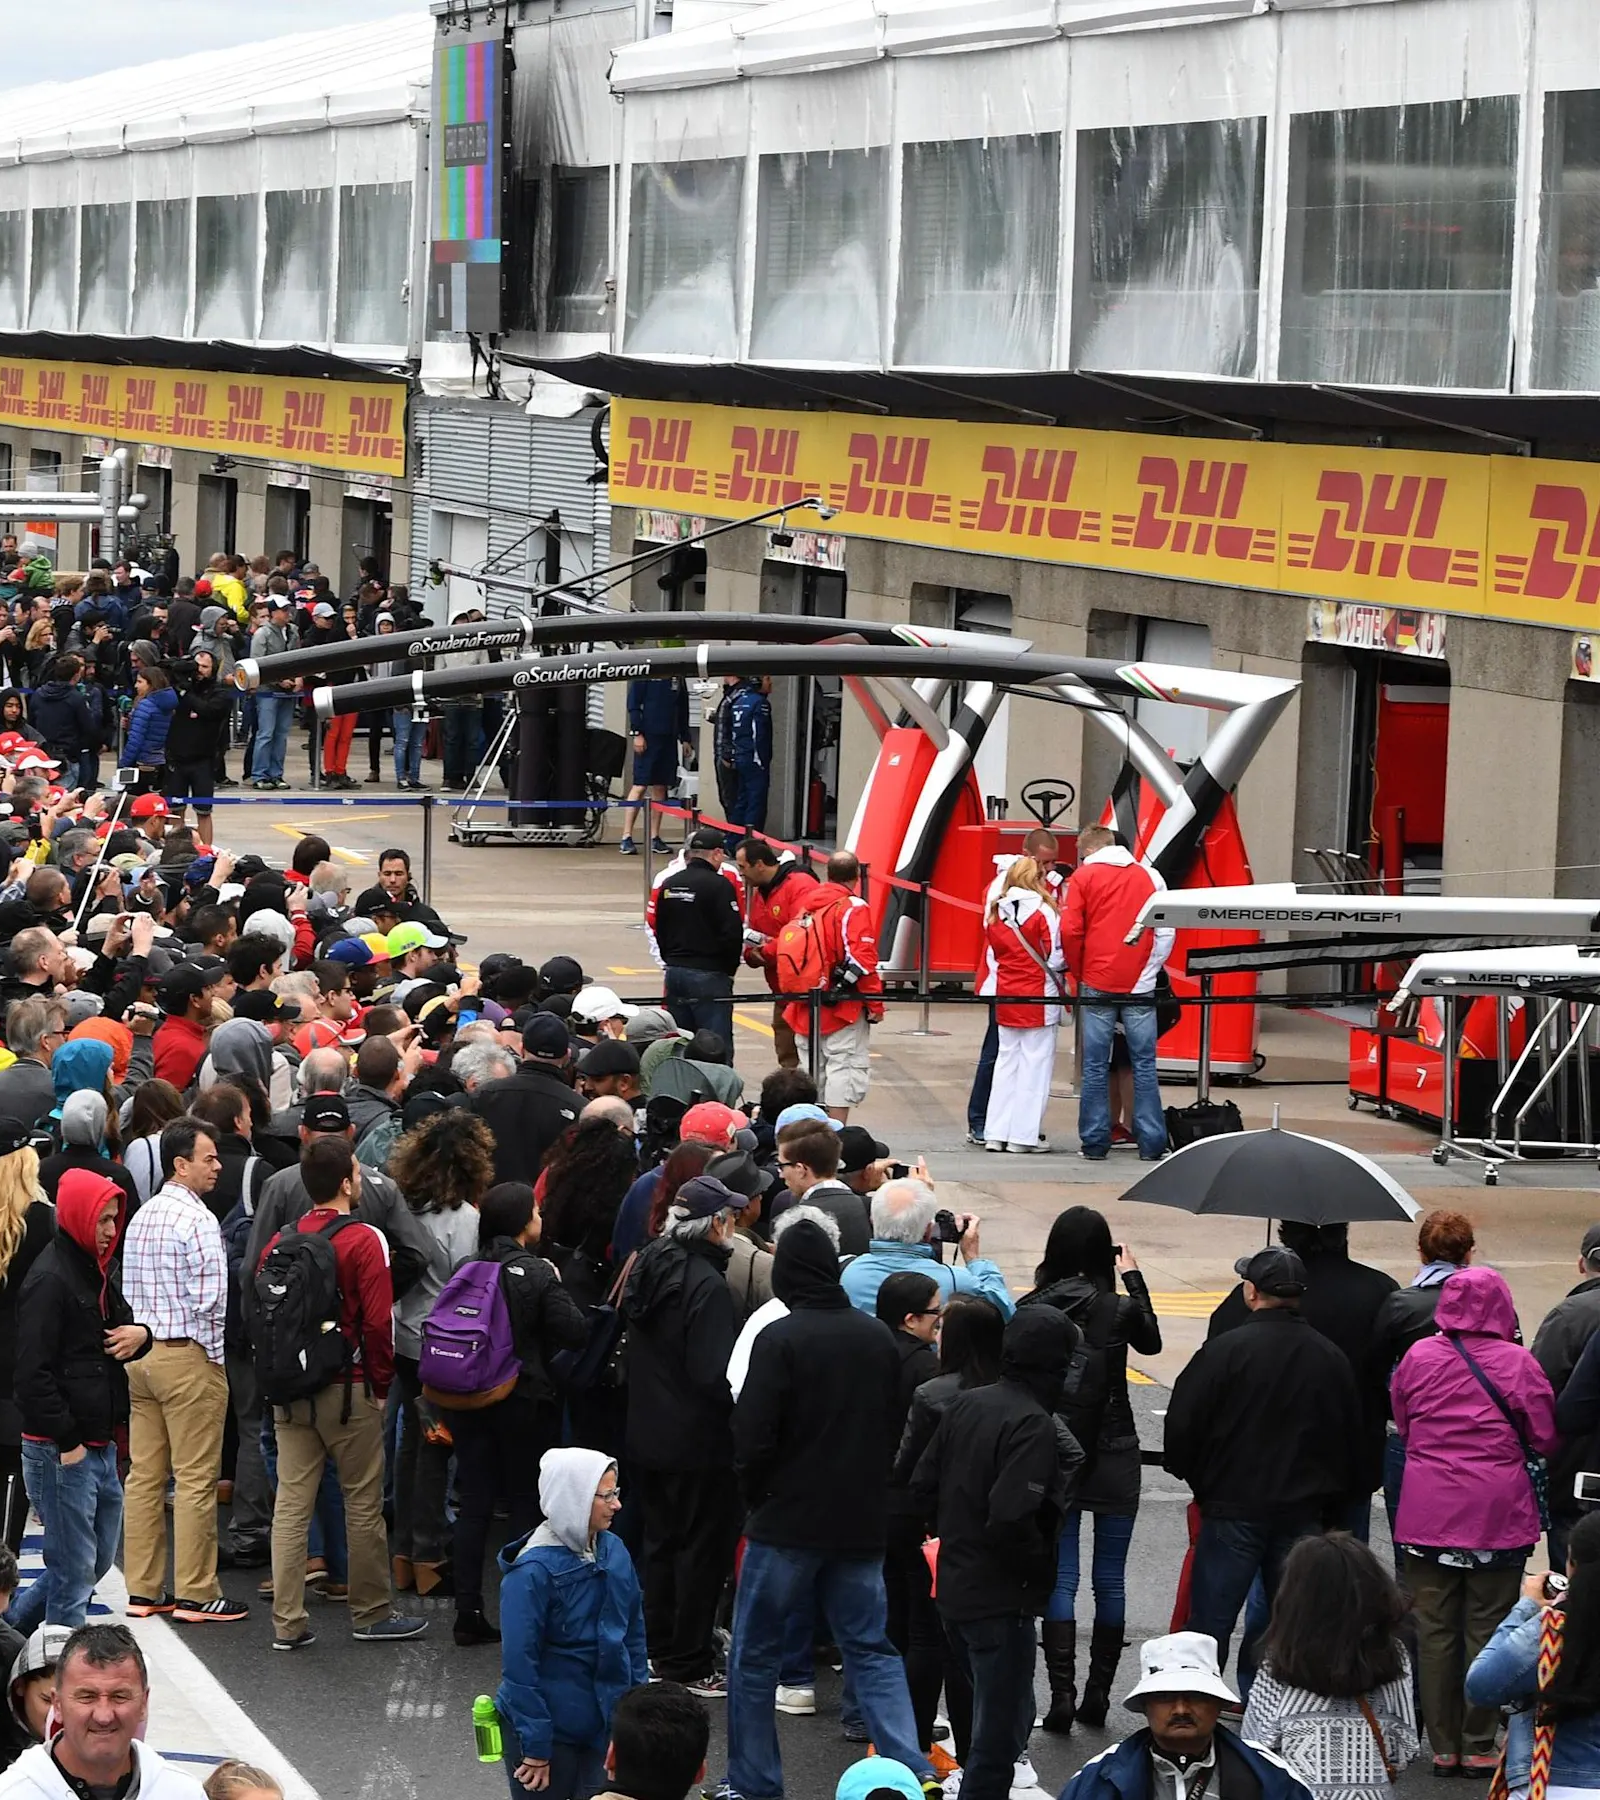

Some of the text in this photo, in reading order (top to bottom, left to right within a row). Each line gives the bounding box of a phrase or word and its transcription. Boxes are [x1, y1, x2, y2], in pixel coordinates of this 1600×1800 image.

[0, 367, 25, 413] DHL
[37, 371, 67, 419] DHL
[81, 374, 110, 426] DHL
[126, 378, 157, 431] DHL
[173, 382, 208, 438] DHL
[227, 385, 266, 444] DHL
[282, 390, 326, 453] DHL
[350, 396, 394, 459] DHL
[626, 417, 696, 493] DHL
[730, 426, 803, 506] DHL
[846, 433, 935, 521] DHL
[978, 446, 1082, 540] DHL
[1133, 457, 1254, 560] DHL
[1310, 471, 1452, 583] DHL
[408, 628, 521, 656] @ScuderiaFerrari
[513, 659, 652, 687] @ScuderiaFerrari
[1198, 908, 1402, 923] @MERCEDESAMGF1
[1416, 1067, 1427, 1088] 7
